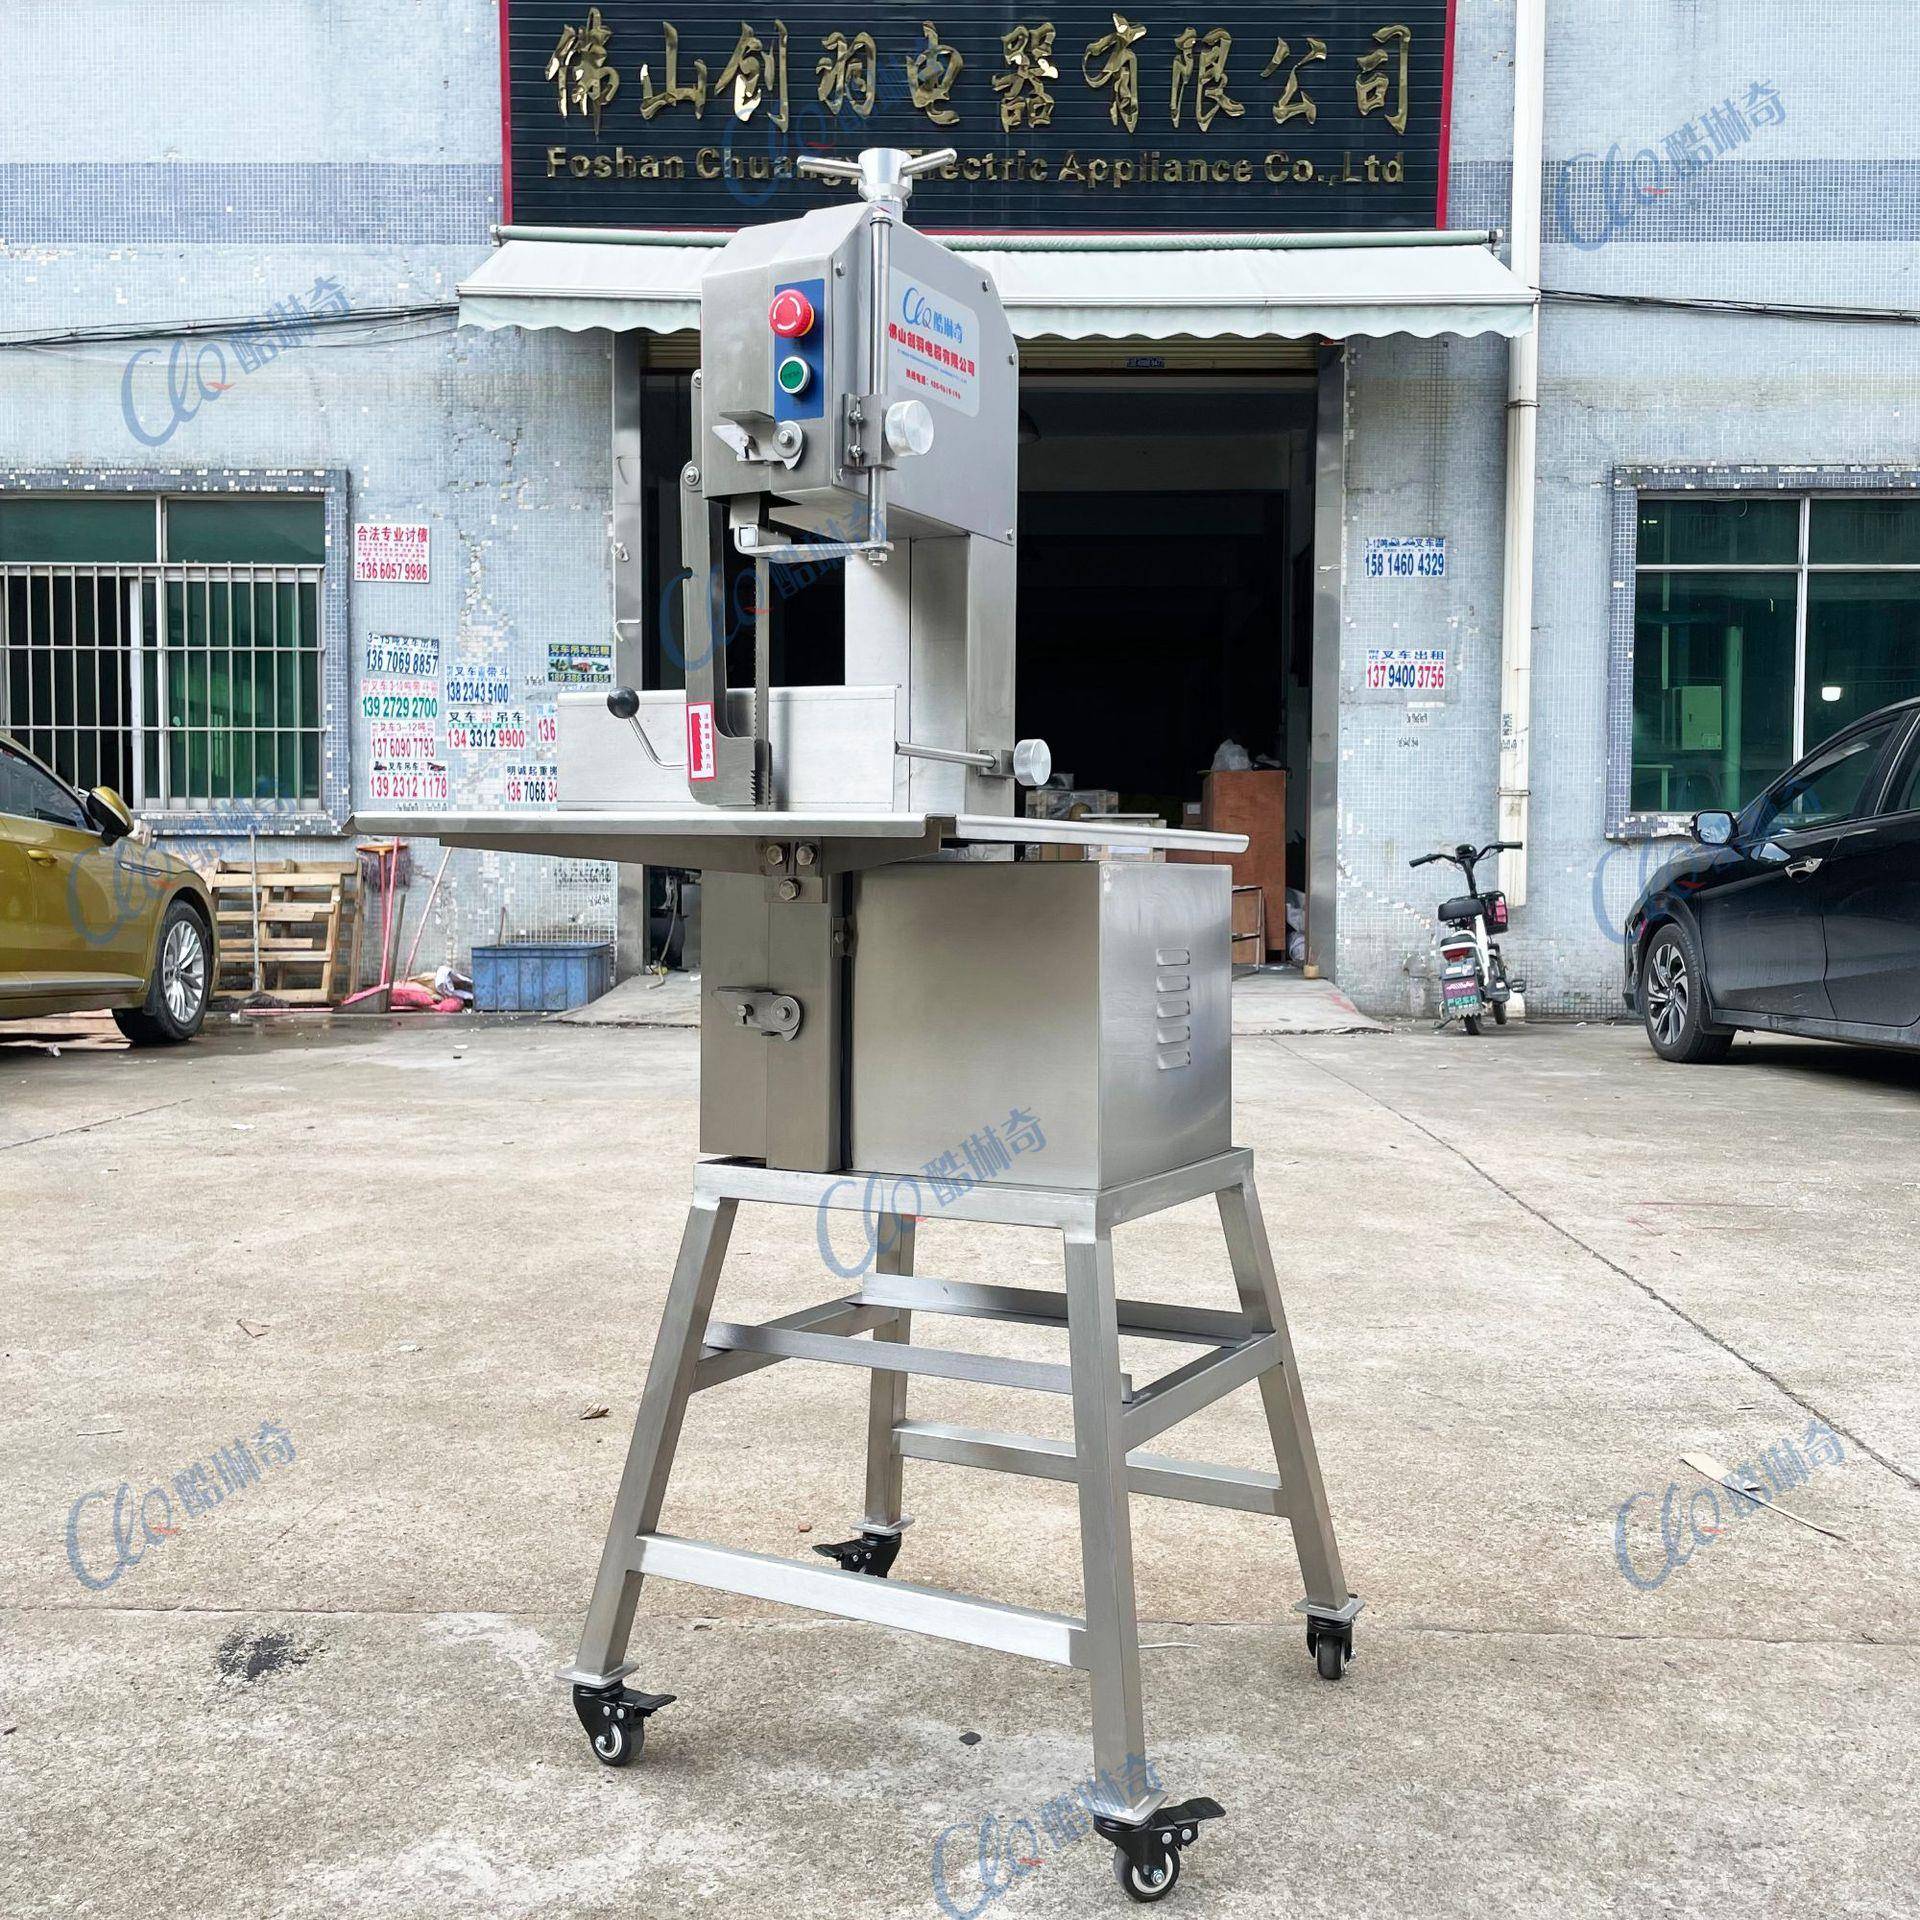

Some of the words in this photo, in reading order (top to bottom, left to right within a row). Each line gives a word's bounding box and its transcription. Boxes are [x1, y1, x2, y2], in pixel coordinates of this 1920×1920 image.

[546, 147, 684, 180] Foshan
[1058, 151, 1252, 188] Appliance
[357, 525, 429, 543] 合法专业讨债
[361, 562, 378, 579] 136
[379, 562, 403, 580] 6057
[404, 563, 428, 581] 9986
[1365, 553, 1384, 576] 158
[1387, 553, 1414, 576] 1460
[1417, 553, 1445, 576] 4329
[366, 649, 384, 670] 136
[386, 650, 411, 675] 7069
[412, 652, 439, 675] 8857
[1382, 650, 1445, 660] 叉车出租
[1367, 664, 1387, 688] 137
[1388, 664, 1416, 688] 9400
[1417, 665, 1444, 689] 3756
[446, 681, 461, 702] 138
[462, 681, 486, 702] 2343
[487, 682, 509, 703] 5100
[363, 696, 381, 718] 139
[382, 696, 410, 718] 2729
[412, 697, 438, 718] 2700
[448, 711, 477, 722] 叉车
[496, 711, 525, 723] 吊车
[448, 729, 467, 748] 134
[469, 729, 497, 748] 3312
[498, 729, 525, 748] 9900
[538, 718, 556, 742] 136
[372, 738, 388, 758] 137
[389, 737, 412, 758] 6090
[413, 738, 435, 758] 7793
[370, 776, 390, 797] 139
[392, 776, 418, 797] 2312
[422, 777, 448, 798] 1178
[507, 781, 522, 801] 136
[524, 781, 546, 802] 7068
